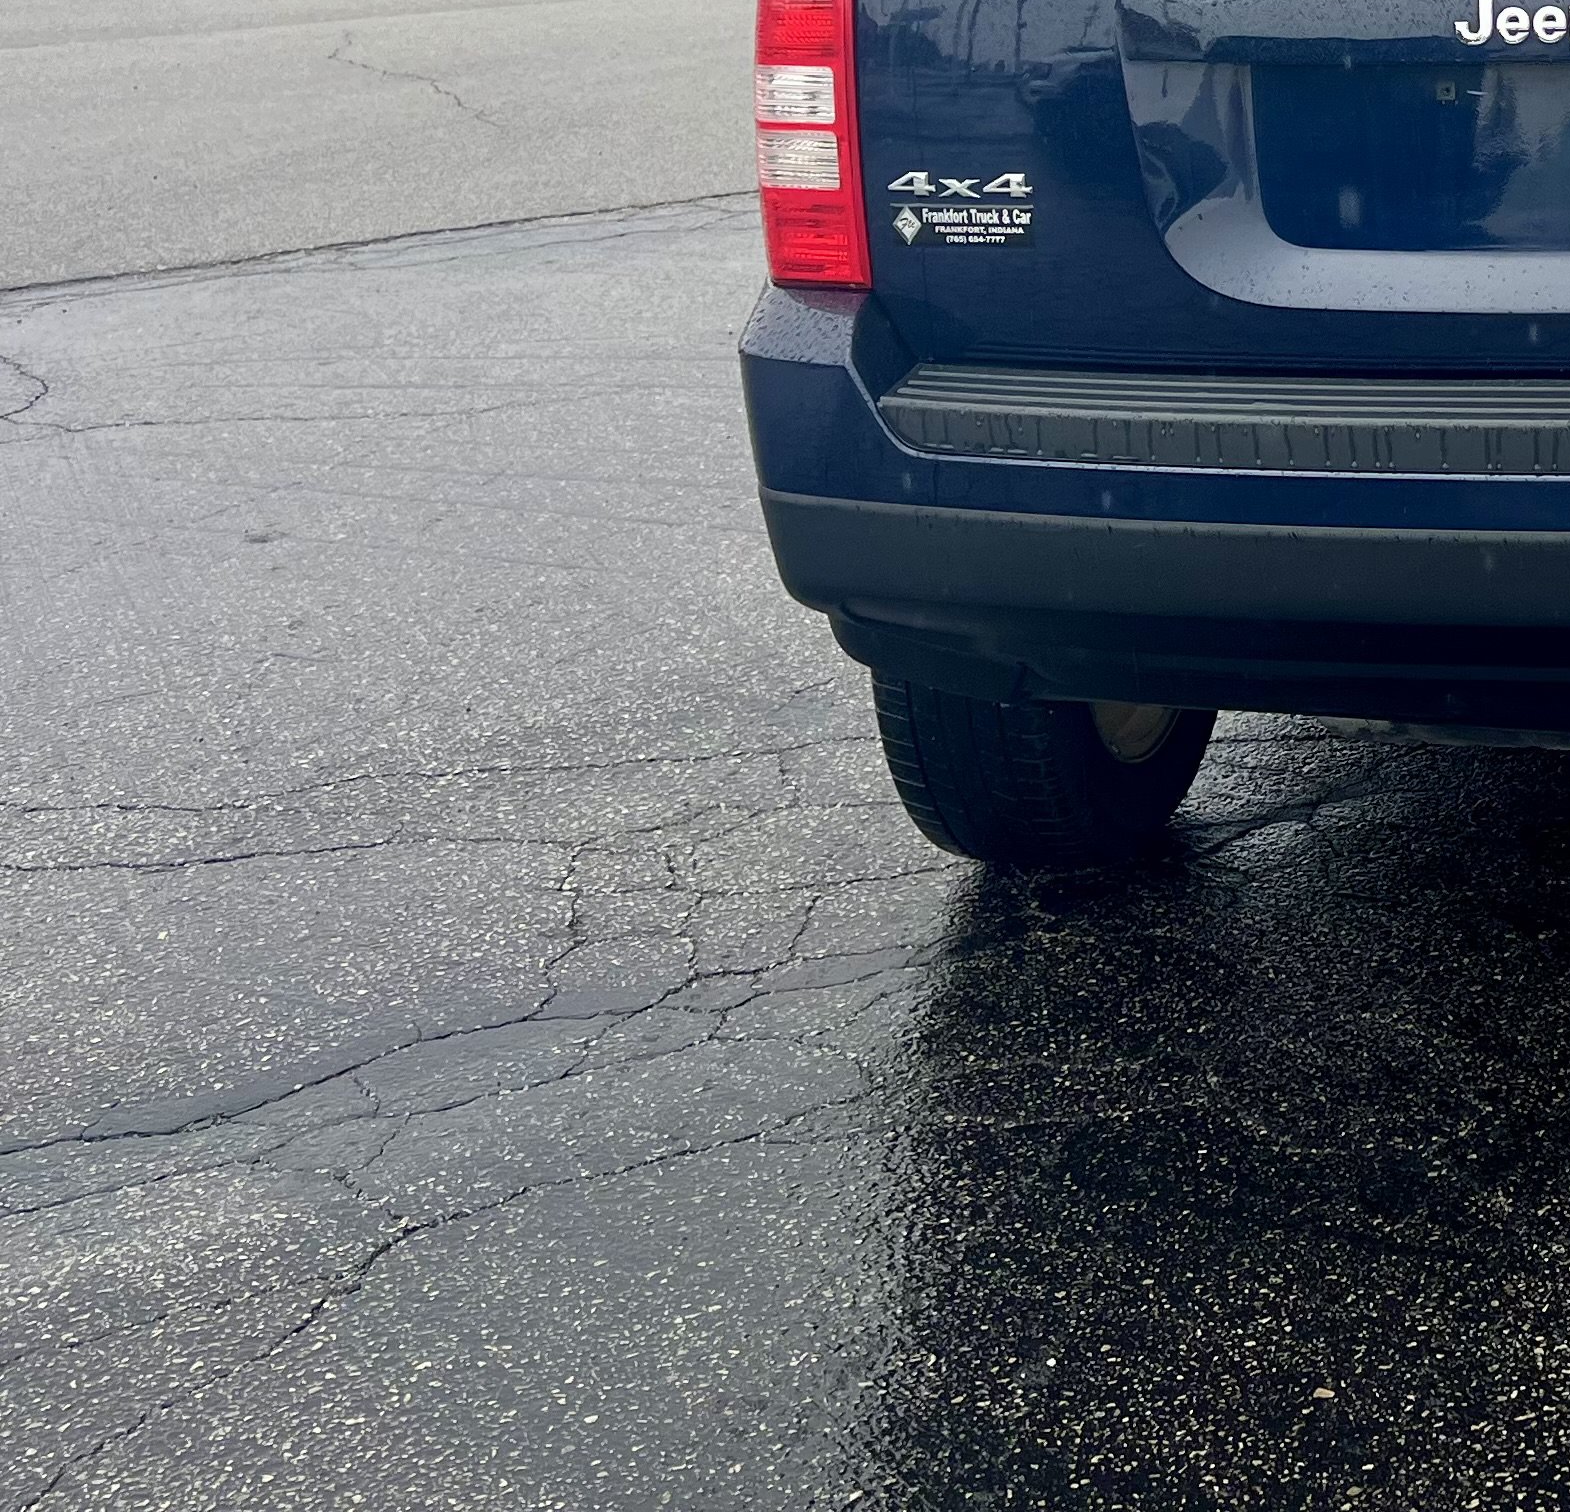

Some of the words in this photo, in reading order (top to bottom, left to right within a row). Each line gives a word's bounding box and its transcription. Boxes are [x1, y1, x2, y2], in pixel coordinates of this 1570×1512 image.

[888, 171, 1033, 198] 4x4
[922, 208, 968, 224] Frankfort
[969, 208, 999, 224] Truck
[1001, 209, 1010, 224] &
[1012, 209, 1031, 224] Car
[935, 226, 987, 234] FRANKFORT,
[988, 226, 1024, 234] INDIANA
